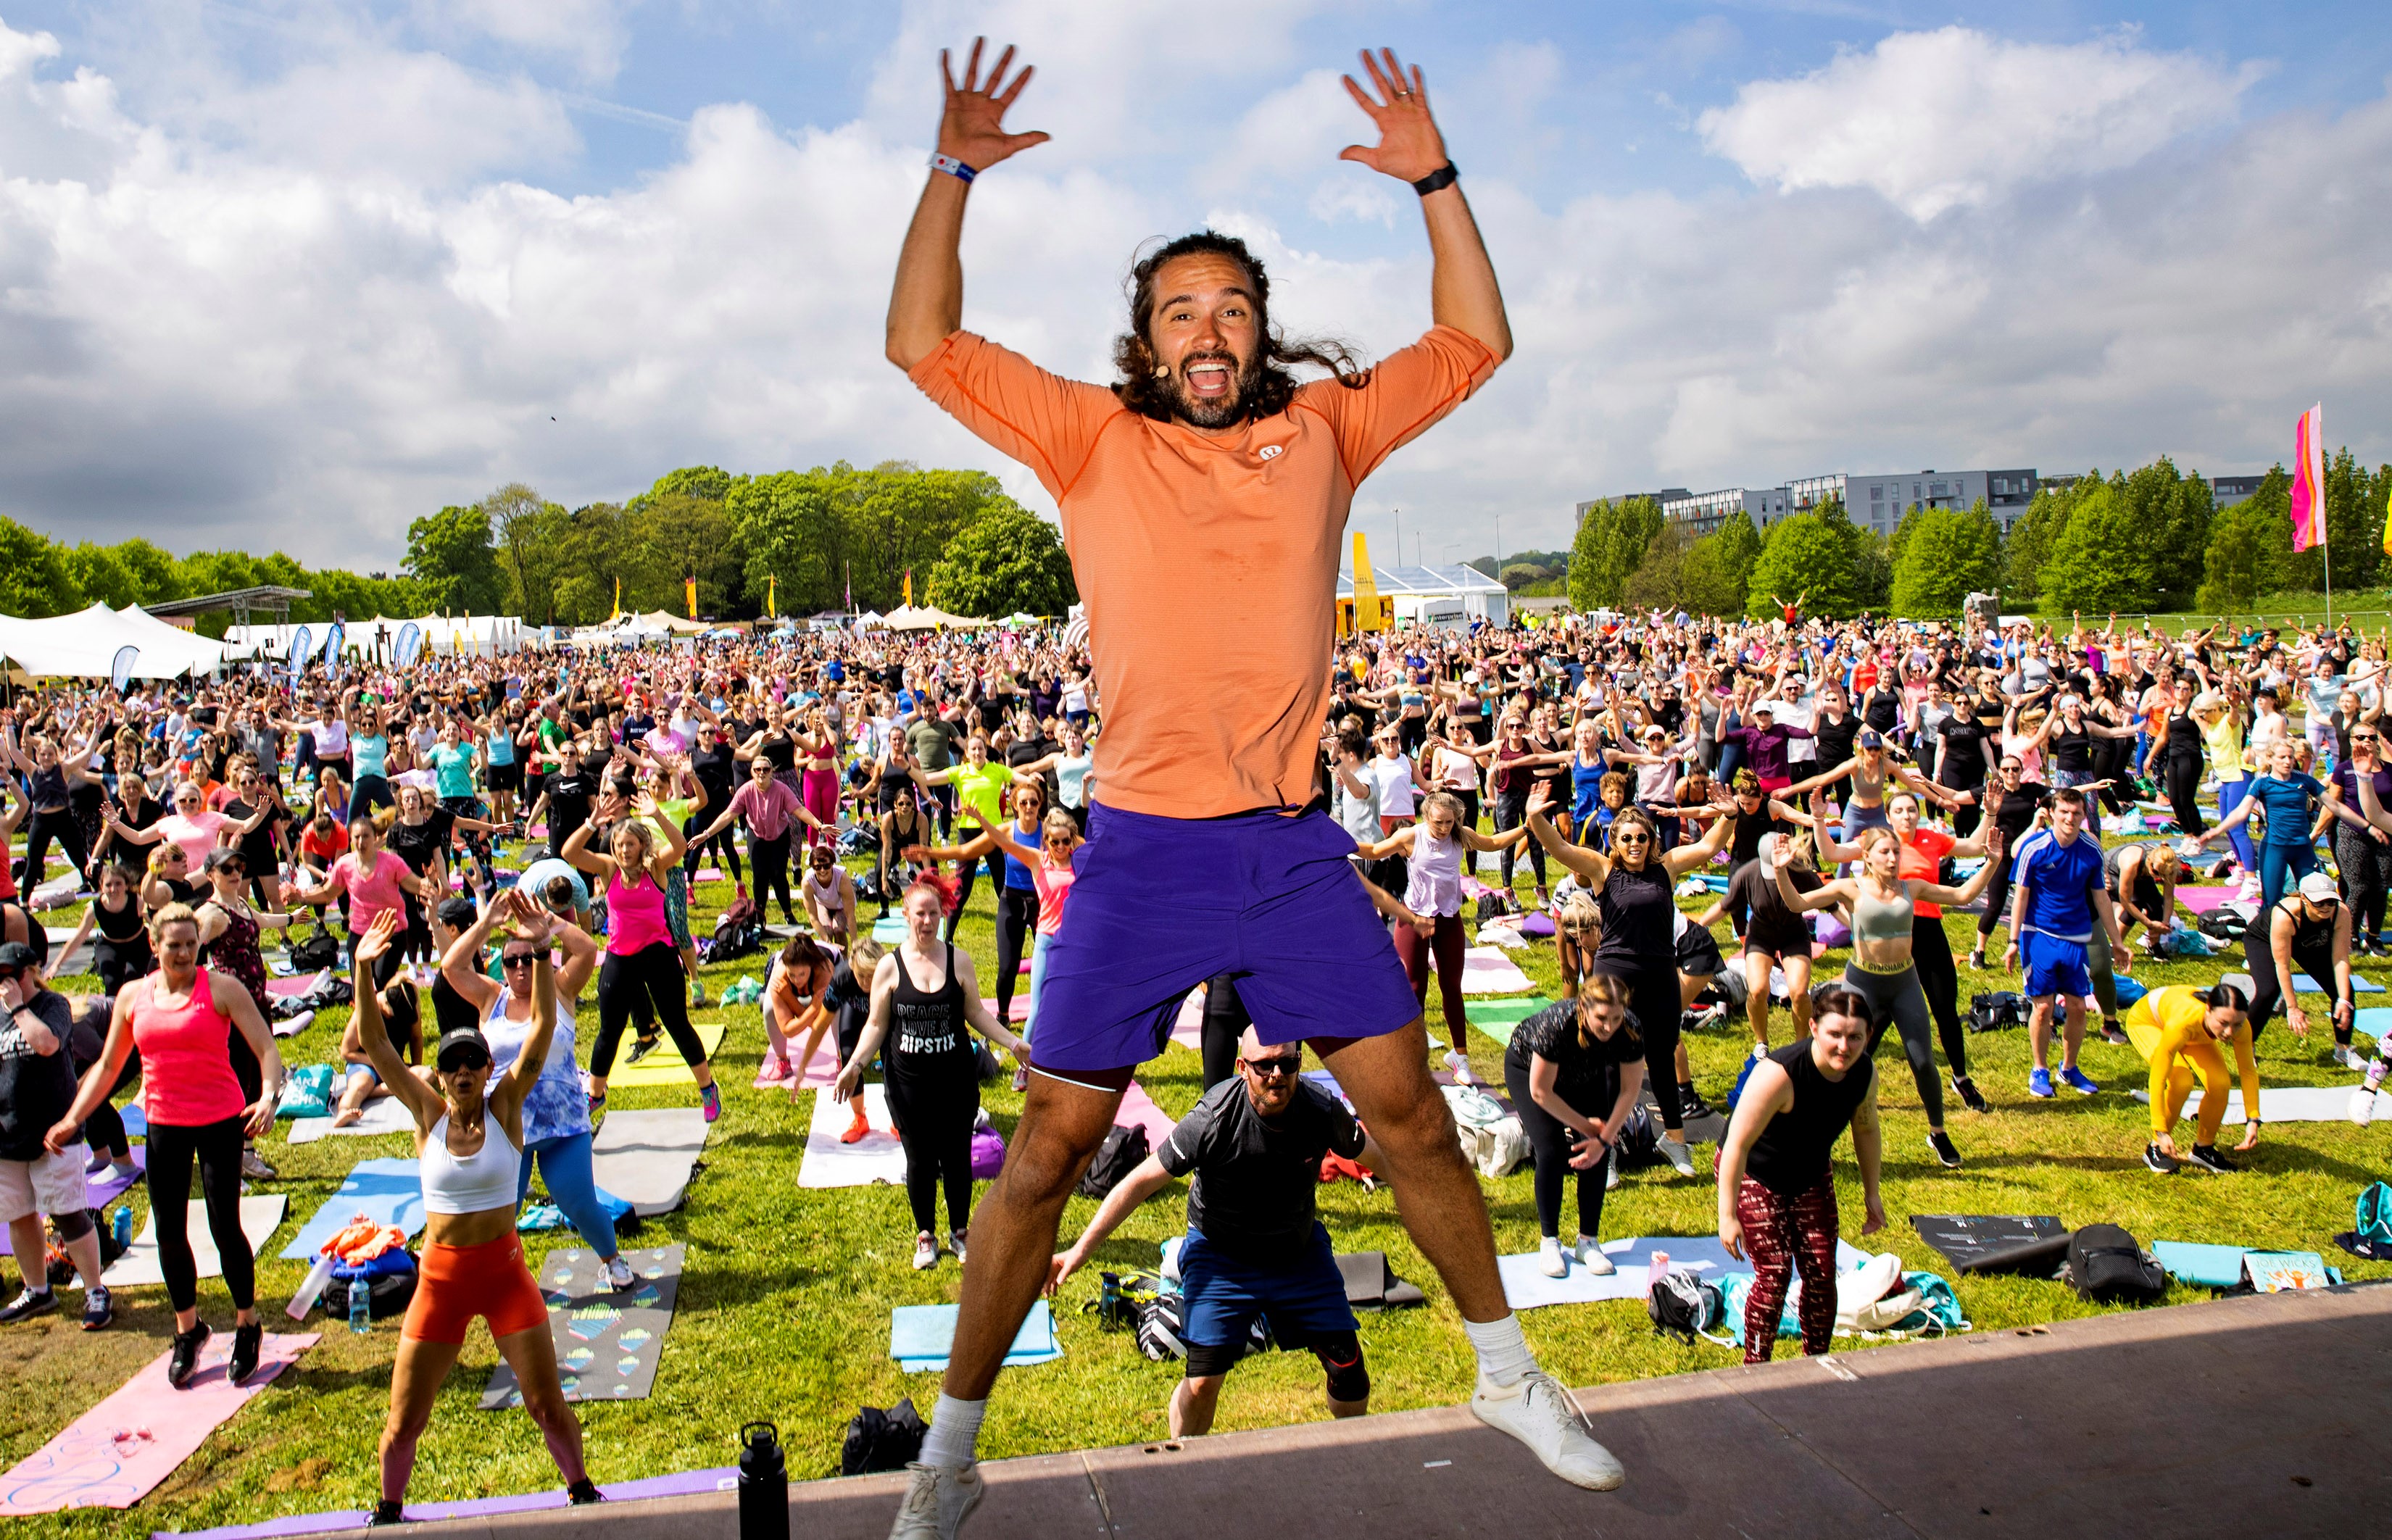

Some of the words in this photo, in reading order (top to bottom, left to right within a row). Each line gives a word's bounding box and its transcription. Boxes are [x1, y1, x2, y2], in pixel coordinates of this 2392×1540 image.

[1429, 612, 1463, 622] nterprise
[1868, 961, 1906, 973] GYMSHARK
[897, 1003, 952, 1020] PEACE,
[902, 1019, 936, 1036] LOVE
[939, 1020, 950, 1036] &
[900, 1033, 956, 1054] RIPSTIX
[2256, 1257, 2275, 1268] JOE
[2278, 1256, 2317, 1269] WICKS
